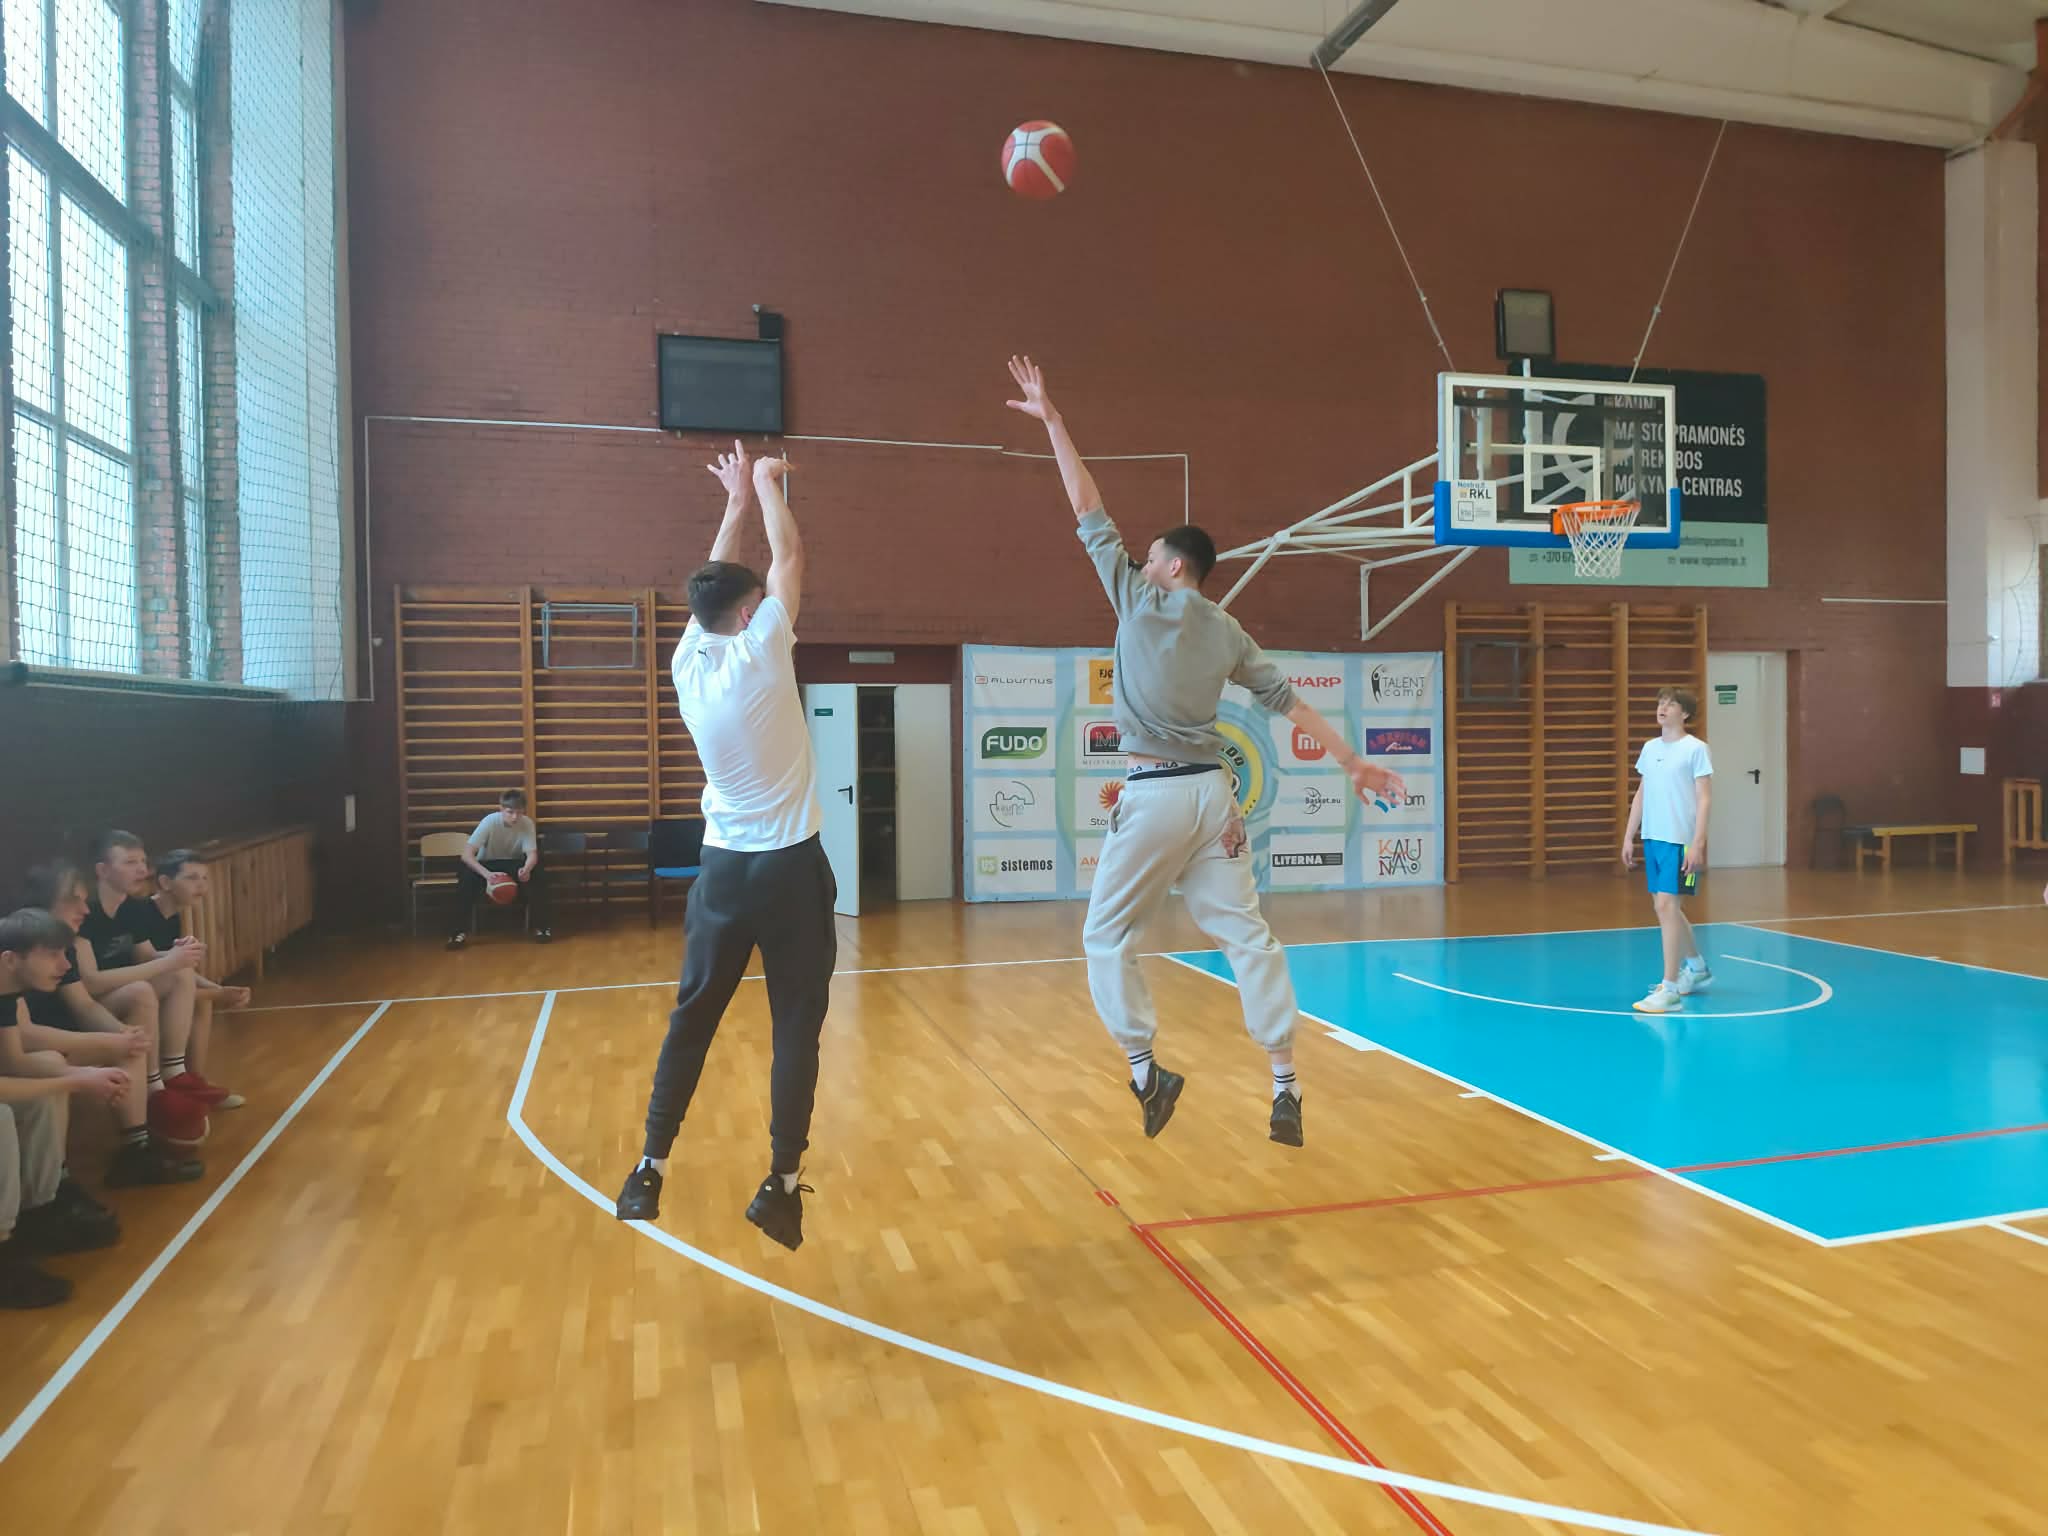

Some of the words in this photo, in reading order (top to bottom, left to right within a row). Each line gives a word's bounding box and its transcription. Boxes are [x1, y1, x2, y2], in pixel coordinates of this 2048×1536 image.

[1682, 477, 1743, 497] CENTRAS
[1469, 489, 1493, 499] RKL
[1287, 676, 1342, 687] HARP
[1382, 676, 1425, 688] TALENT
[986, 736, 1043, 751] FUDO
[1155, 761, 1178, 769] FILA
[1274, 854, 1323, 865] LITERNA
[1001, 859, 1053, 872] sistemos
